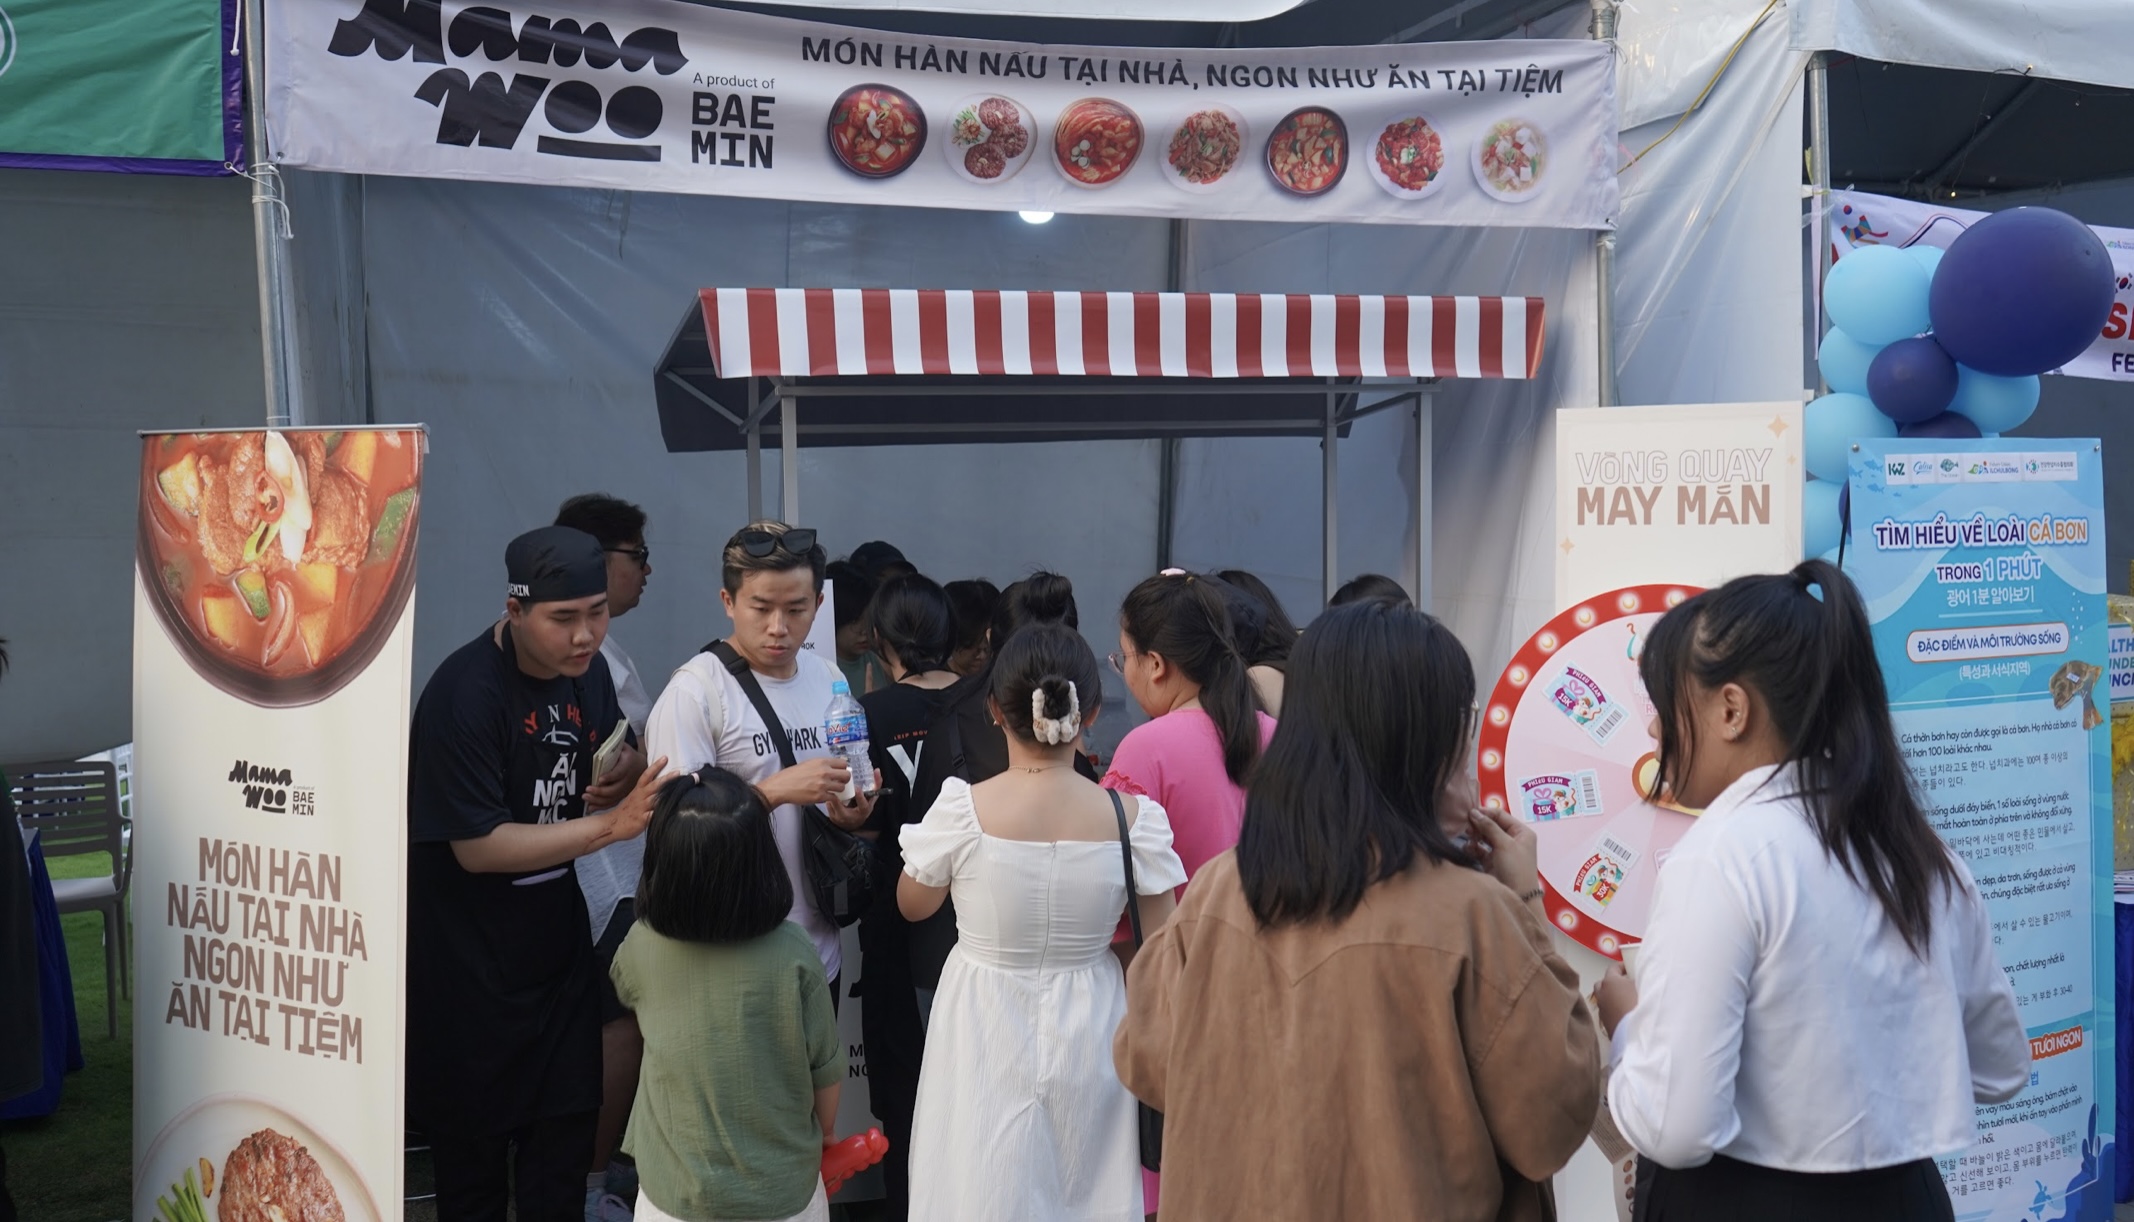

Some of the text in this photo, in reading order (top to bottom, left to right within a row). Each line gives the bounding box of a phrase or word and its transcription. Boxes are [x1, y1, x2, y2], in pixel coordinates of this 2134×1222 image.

[327, 0, 690, 76] Mama
[802, 36, 883, 68] MÓN
[895, 44, 968, 74] HÀN
[1058, 57, 1108, 86] TẠI
[1118, 58, 1198, 90] NHÀ,
[1206, 64, 1299, 88] NGON
[1308, 67, 1378, 88] NHƯ
[1388, 63, 1431, 90] ĂN
[1437, 69, 1486, 97] TẠI
[1495, 63, 1564, 99] TIỆM
[693, 73, 775, 90] A product of
[693, 91, 776, 131] BAE
[691, 130, 774, 169] MIN
[1575, 447, 1773, 485] VÒNG QUAY
[1577, 484, 1770, 526] MAY MẮN
[1876, 515, 2087, 547] TÌM HIỂU VỀ LOÀI CÁ BƠN
[1937, 553, 2041, 580] TRONG 1 PHÚT
[1947, 585, 2034, 607] 광어 1분 알아보기
[1918, 629, 2061, 655] ĐẶC ĐIỂM VÀ MÔI TRƯỜNG SỐNG
[1991, 661, 2031, 678] 서식지역)
[1558, 692, 1572, 707] 15K
[1901, 733, 1912, 743] Cá
[1946, 731, 1960, 742] hay
[1961, 728, 1973, 739] còn
[1973, 728, 1990, 739] được
[1991, 726, 2001, 738] gọi
[2002, 724, 2008, 735] là
[2009, 724, 2017, 735] cá
[2032, 722, 2040, 733] Họ
[2041, 721, 2052, 731] nhà
[1913, 748, 1927, 758] hơn
[1928, 746, 1942, 756] 100
[1943, 744, 1956, 755] loài
[1957, 743, 1973, 754] khác
[228, 759, 293, 787] Mama
[1930, 761, 1968, 776] 넙치라고도
[1989, 757, 2024, 771] 넙치과에는
[1947, 776, 1966, 788] 있다.
[242, 784, 287, 814] Woo
[293, 791, 314, 803] BAE
[1931, 804, 1948, 817] sống
[1950, 803, 1965, 814] dưới
[1966, 802, 1980, 814] đáy
[2002, 797, 2009, 809] số
[2010, 796, 2021, 807] loài
[2022, 795, 2037, 807] sống
[2042, 793, 2056, 804] vùng
[292, 803, 314, 816] MIN
[1537, 805, 1552, 815] 15K
[1953, 818, 1971, 828] hoàn
[1972, 816, 1988, 826] toàn
[2009, 812, 2022, 822] trên
[2023, 810, 2030, 820] và
[2031, 808, 2049, 820] không
[199, 837, 341, 903] MÓN HÀN
[1998, 872, 2006, 883] da
[2023, 868, 2038, 881] sống
[1597, 883, 1609, 898] 30K
[1990, 888, 2011, 900] chúng
[237, 893, 290, 948] TẠI
[299, 903, 368, 962] NHÀ
[184, 934, 349, 1007] NGON NHƯ
[166, 981, 363, 1064] ĂN TẠI TIỆM
[2056, 1029, 2081, 1050] NGON
